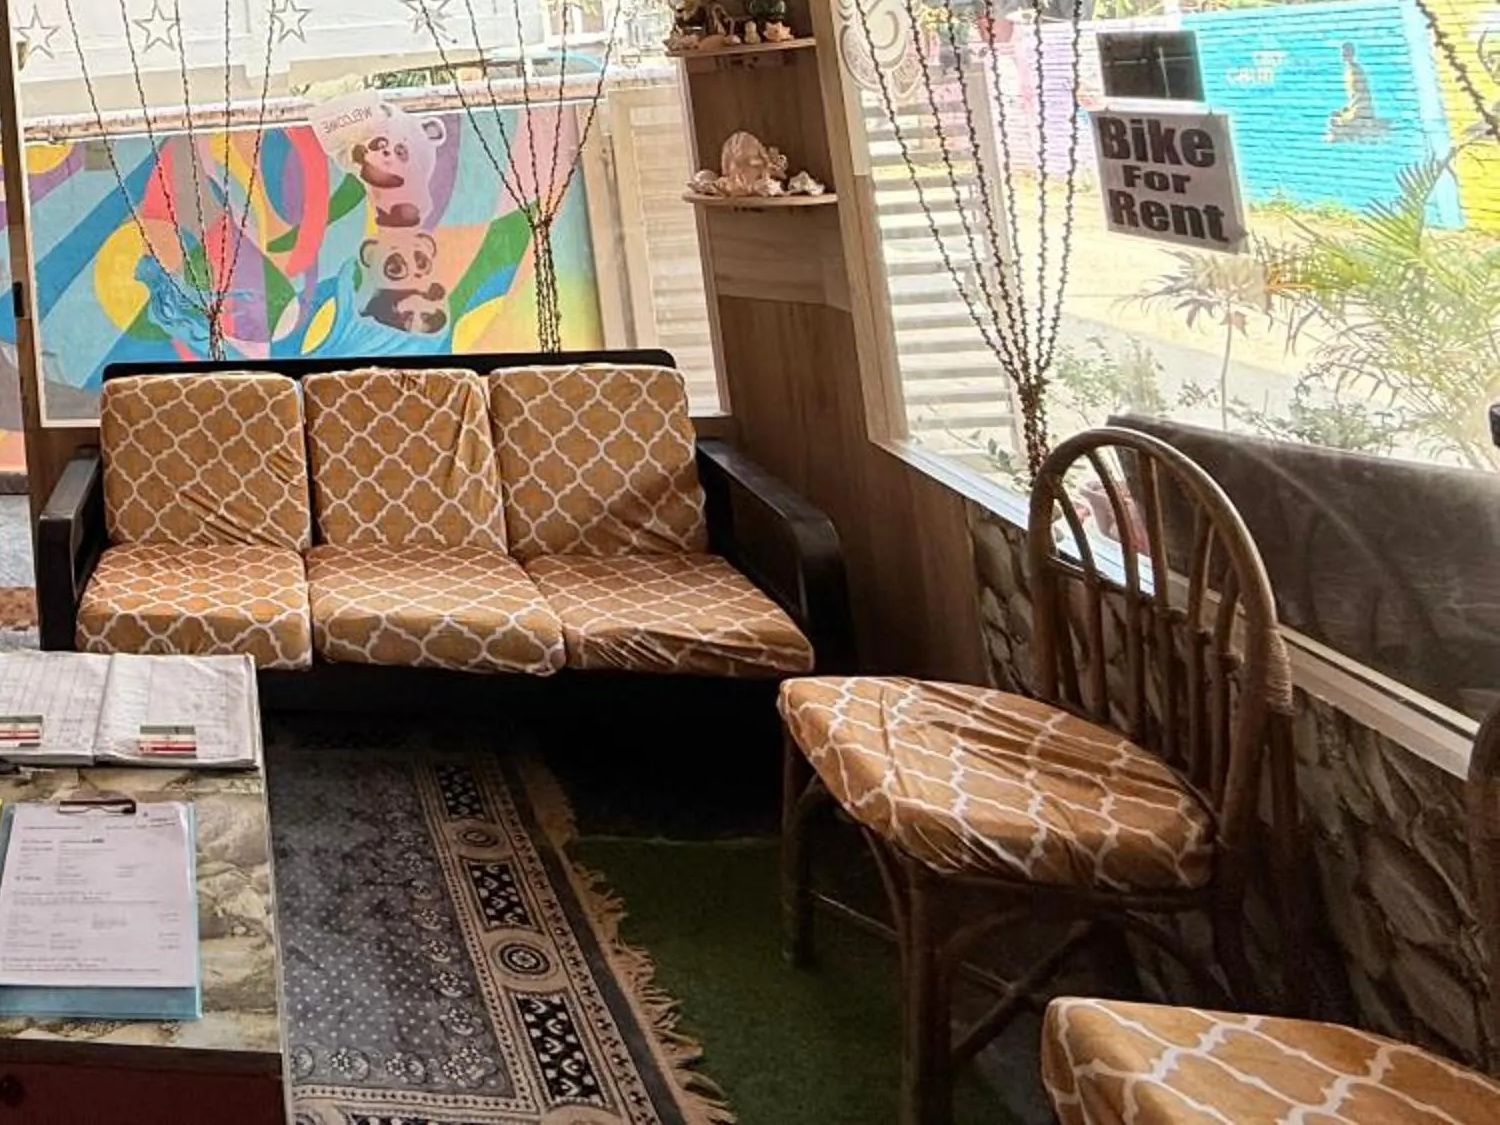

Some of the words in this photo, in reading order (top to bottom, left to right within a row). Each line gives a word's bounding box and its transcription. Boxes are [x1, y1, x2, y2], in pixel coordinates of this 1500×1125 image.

[1097, 117, 1216, 168] Bike
[1121, 163, 1191, 194] For
[1108, 188, 1230, 243] Rent
